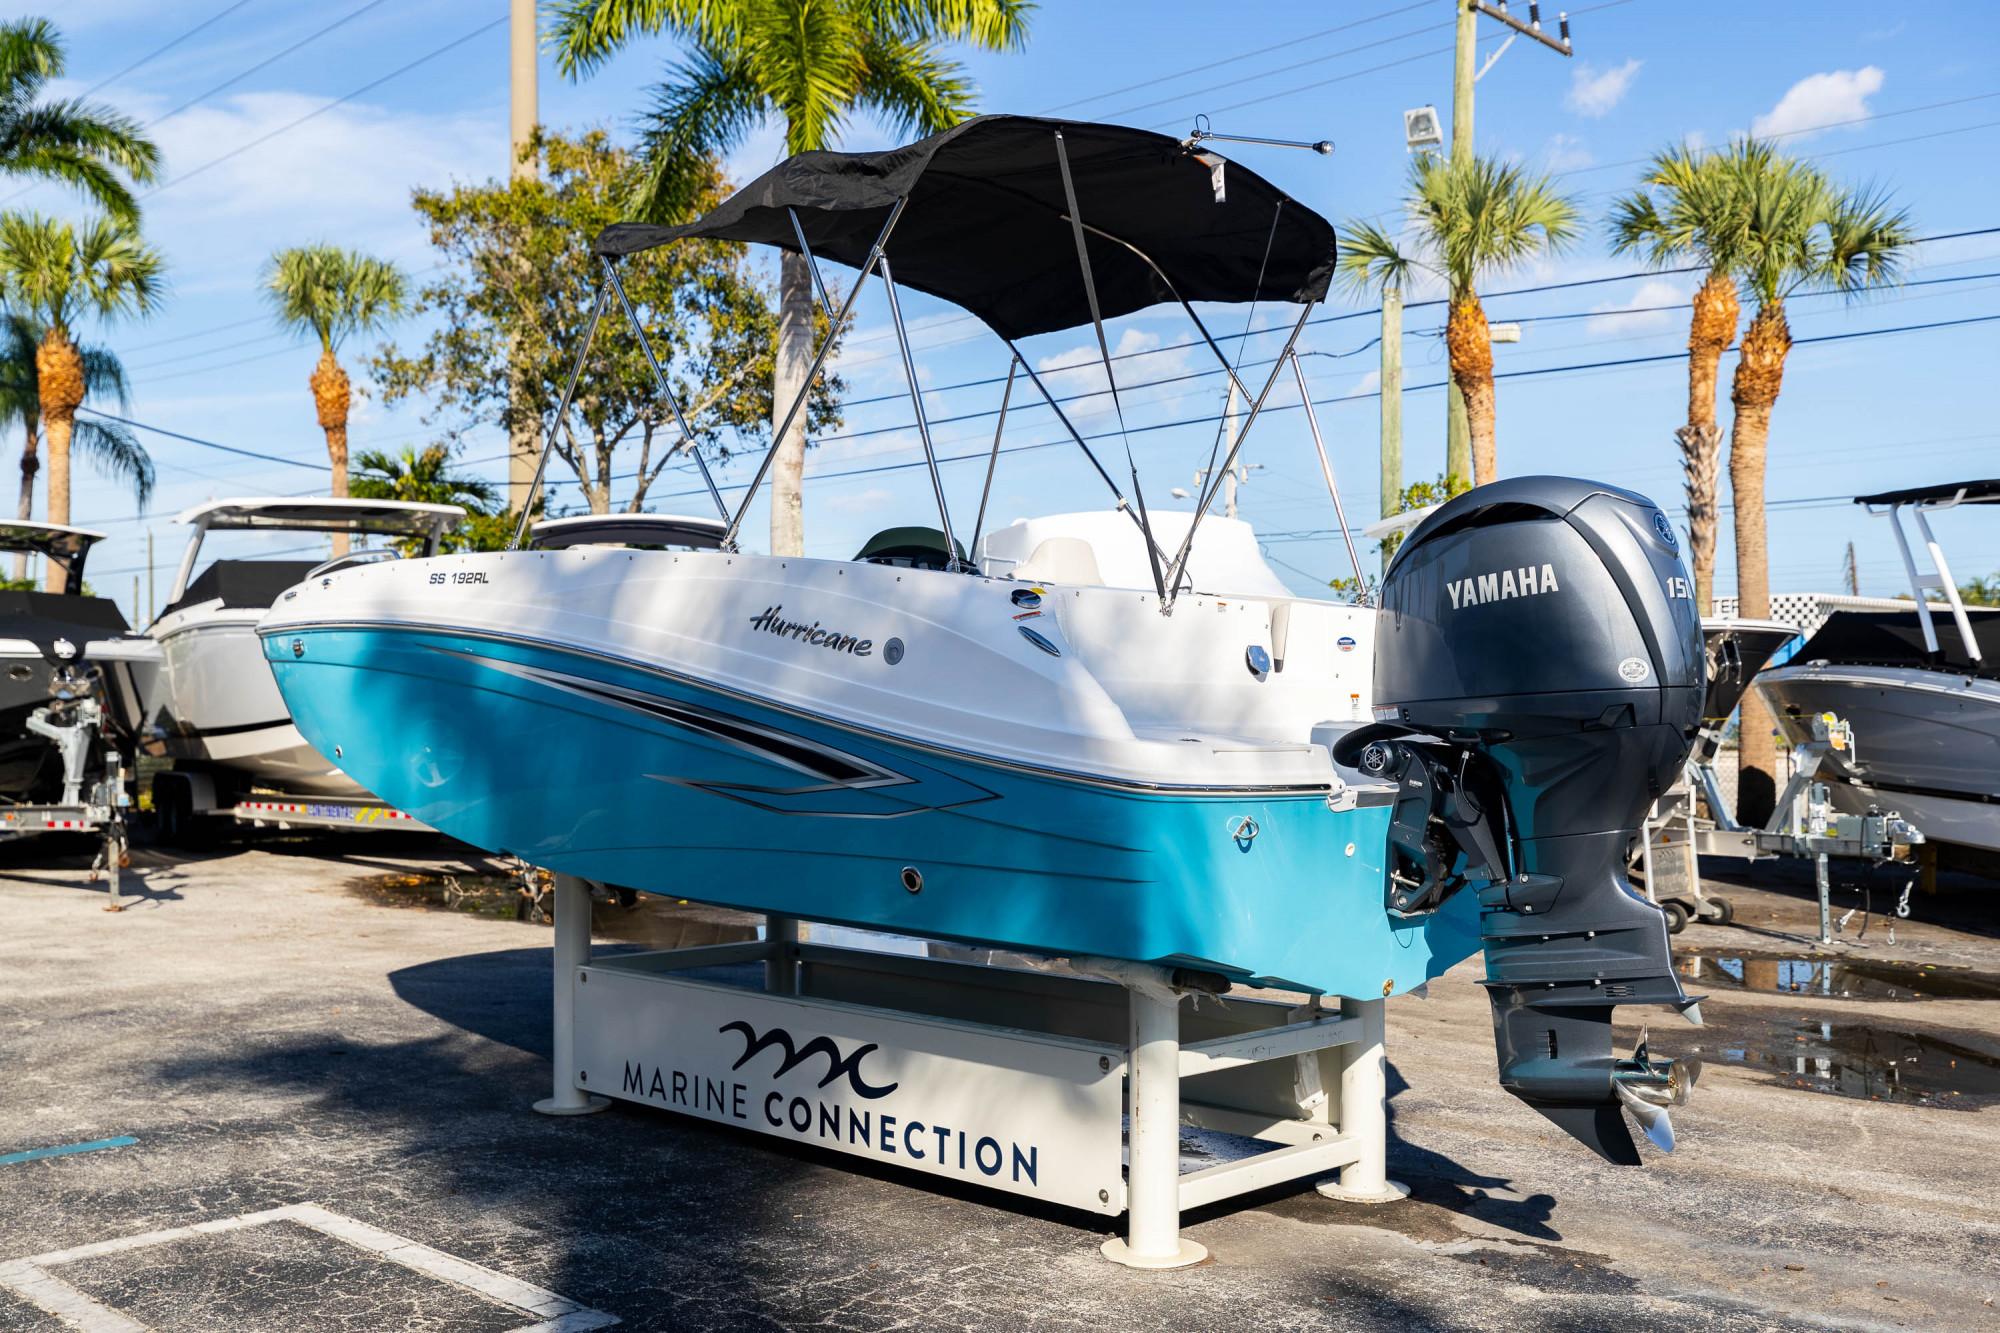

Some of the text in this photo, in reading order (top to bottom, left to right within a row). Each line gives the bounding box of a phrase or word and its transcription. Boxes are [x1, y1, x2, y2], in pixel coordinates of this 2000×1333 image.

[429, 572, 489, 584] SS 192RL
[1446, 563, 1559, 610] YAMAHA
[750, 604, 873, 657] Hurricane
[623, 1060, 1038, 1187] MARINE CONNECTION
